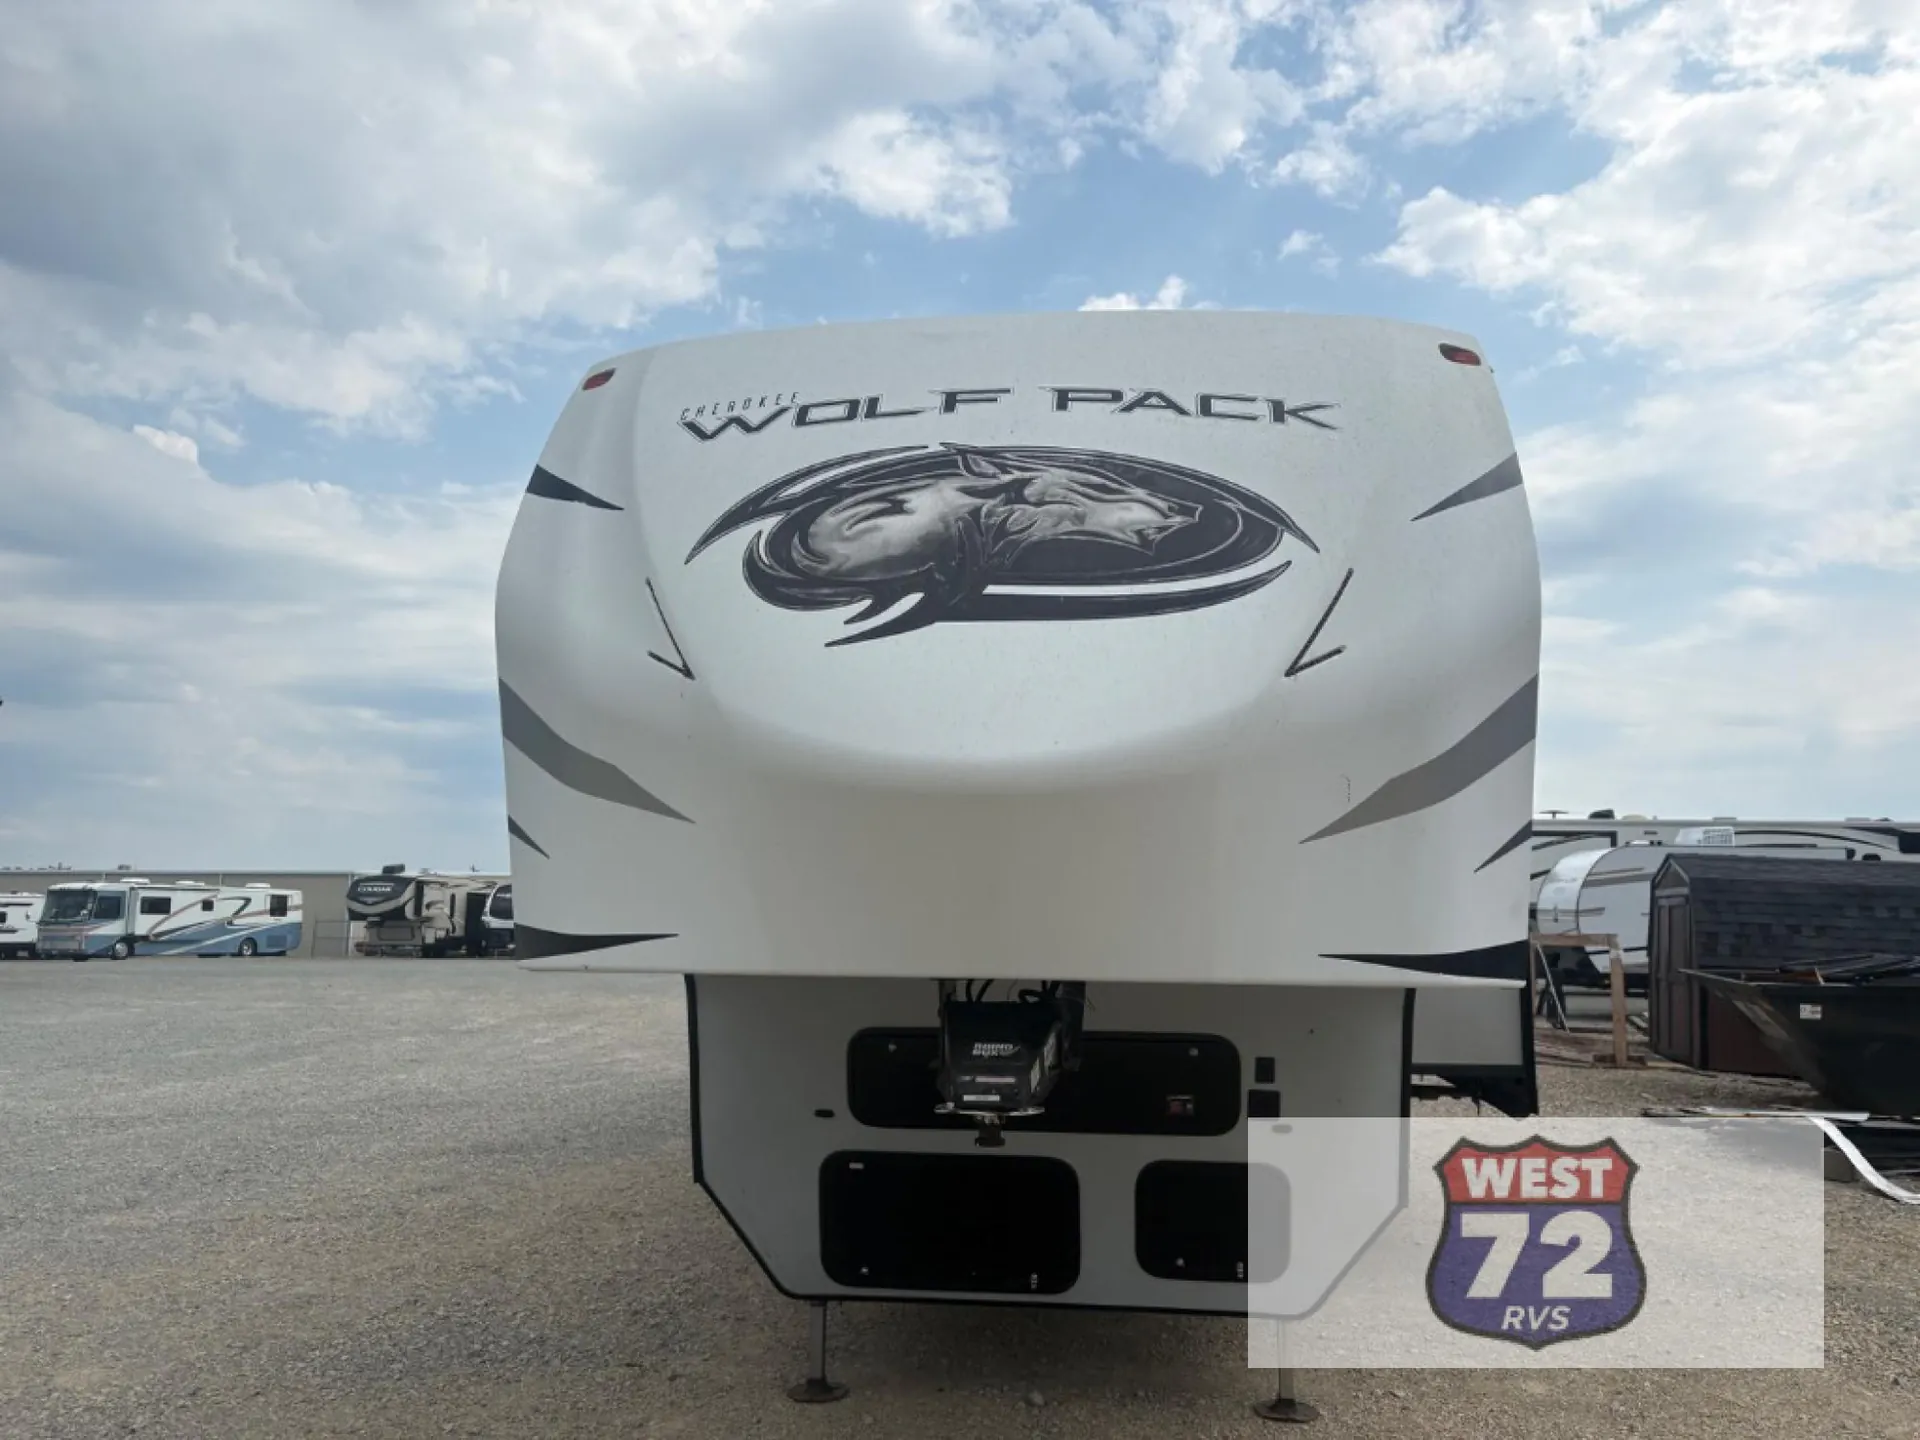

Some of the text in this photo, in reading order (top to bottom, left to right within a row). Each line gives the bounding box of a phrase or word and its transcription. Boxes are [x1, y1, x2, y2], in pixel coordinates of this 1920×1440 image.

[677, 386, 1341, 443] WOLF PACK
[680, 391, 800, 421] CHEROKEE
